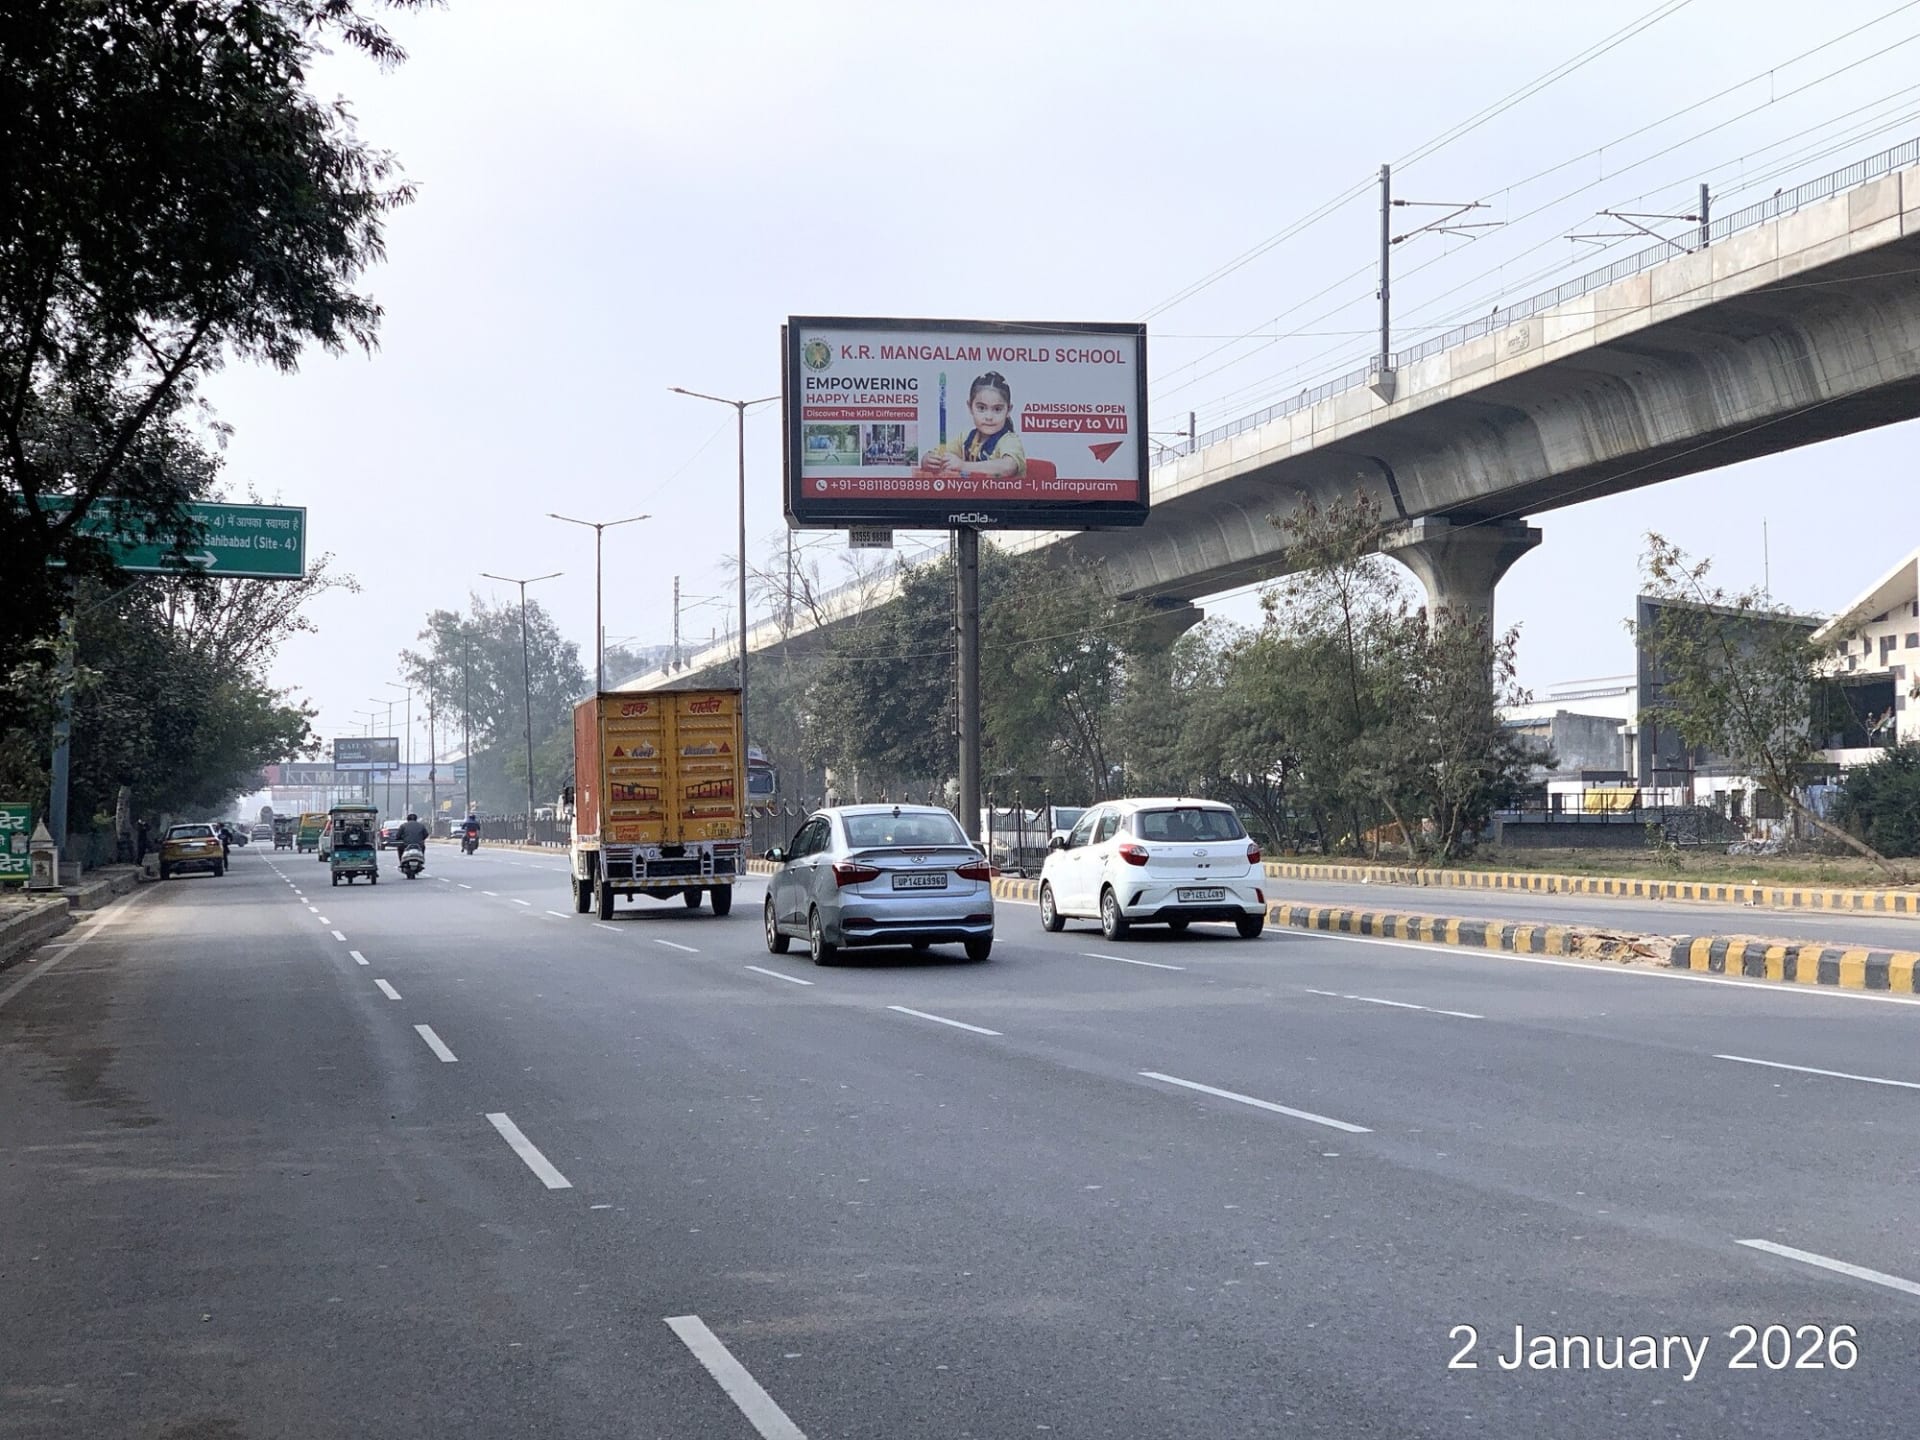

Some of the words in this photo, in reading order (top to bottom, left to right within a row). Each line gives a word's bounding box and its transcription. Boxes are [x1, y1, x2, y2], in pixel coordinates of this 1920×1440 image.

[841, 345, 875, 360] K.R.
[881, 345, 981, 361] MANGALAM
[986, 347, 1050, 363] WORLD
[1055, 348, 1126, 364] SCHOOL
[806, 377, 918, 391] EMPOWERING
[806, 394, 849, 404] HAPPY
[853, 394, 919, 404] LEARNERS
[807, 409, 839, 417] Discover
[876, 410, 915, 418] Difference
[1024, 403, 1092, 413] ADMISSIONS
[1095, 404, 1125, 414] OPEN
[1024, 415, 1083, 432] Nursery
[1086, 418, 1101, 430] to
[1105, 418, 1124, 430] VII
[830, 479, 930, 491] +91-9811809898
[947, 479, 979, 492] Nyay
[982, 479, 1021, 490] Khand
[1041, 480, 1118, 493] Indirapuram
[236, 516, 262, 528] आपका
[265, 517, 290, 529] स्वागत
[204, 534, 251, 548] Sahibabad
